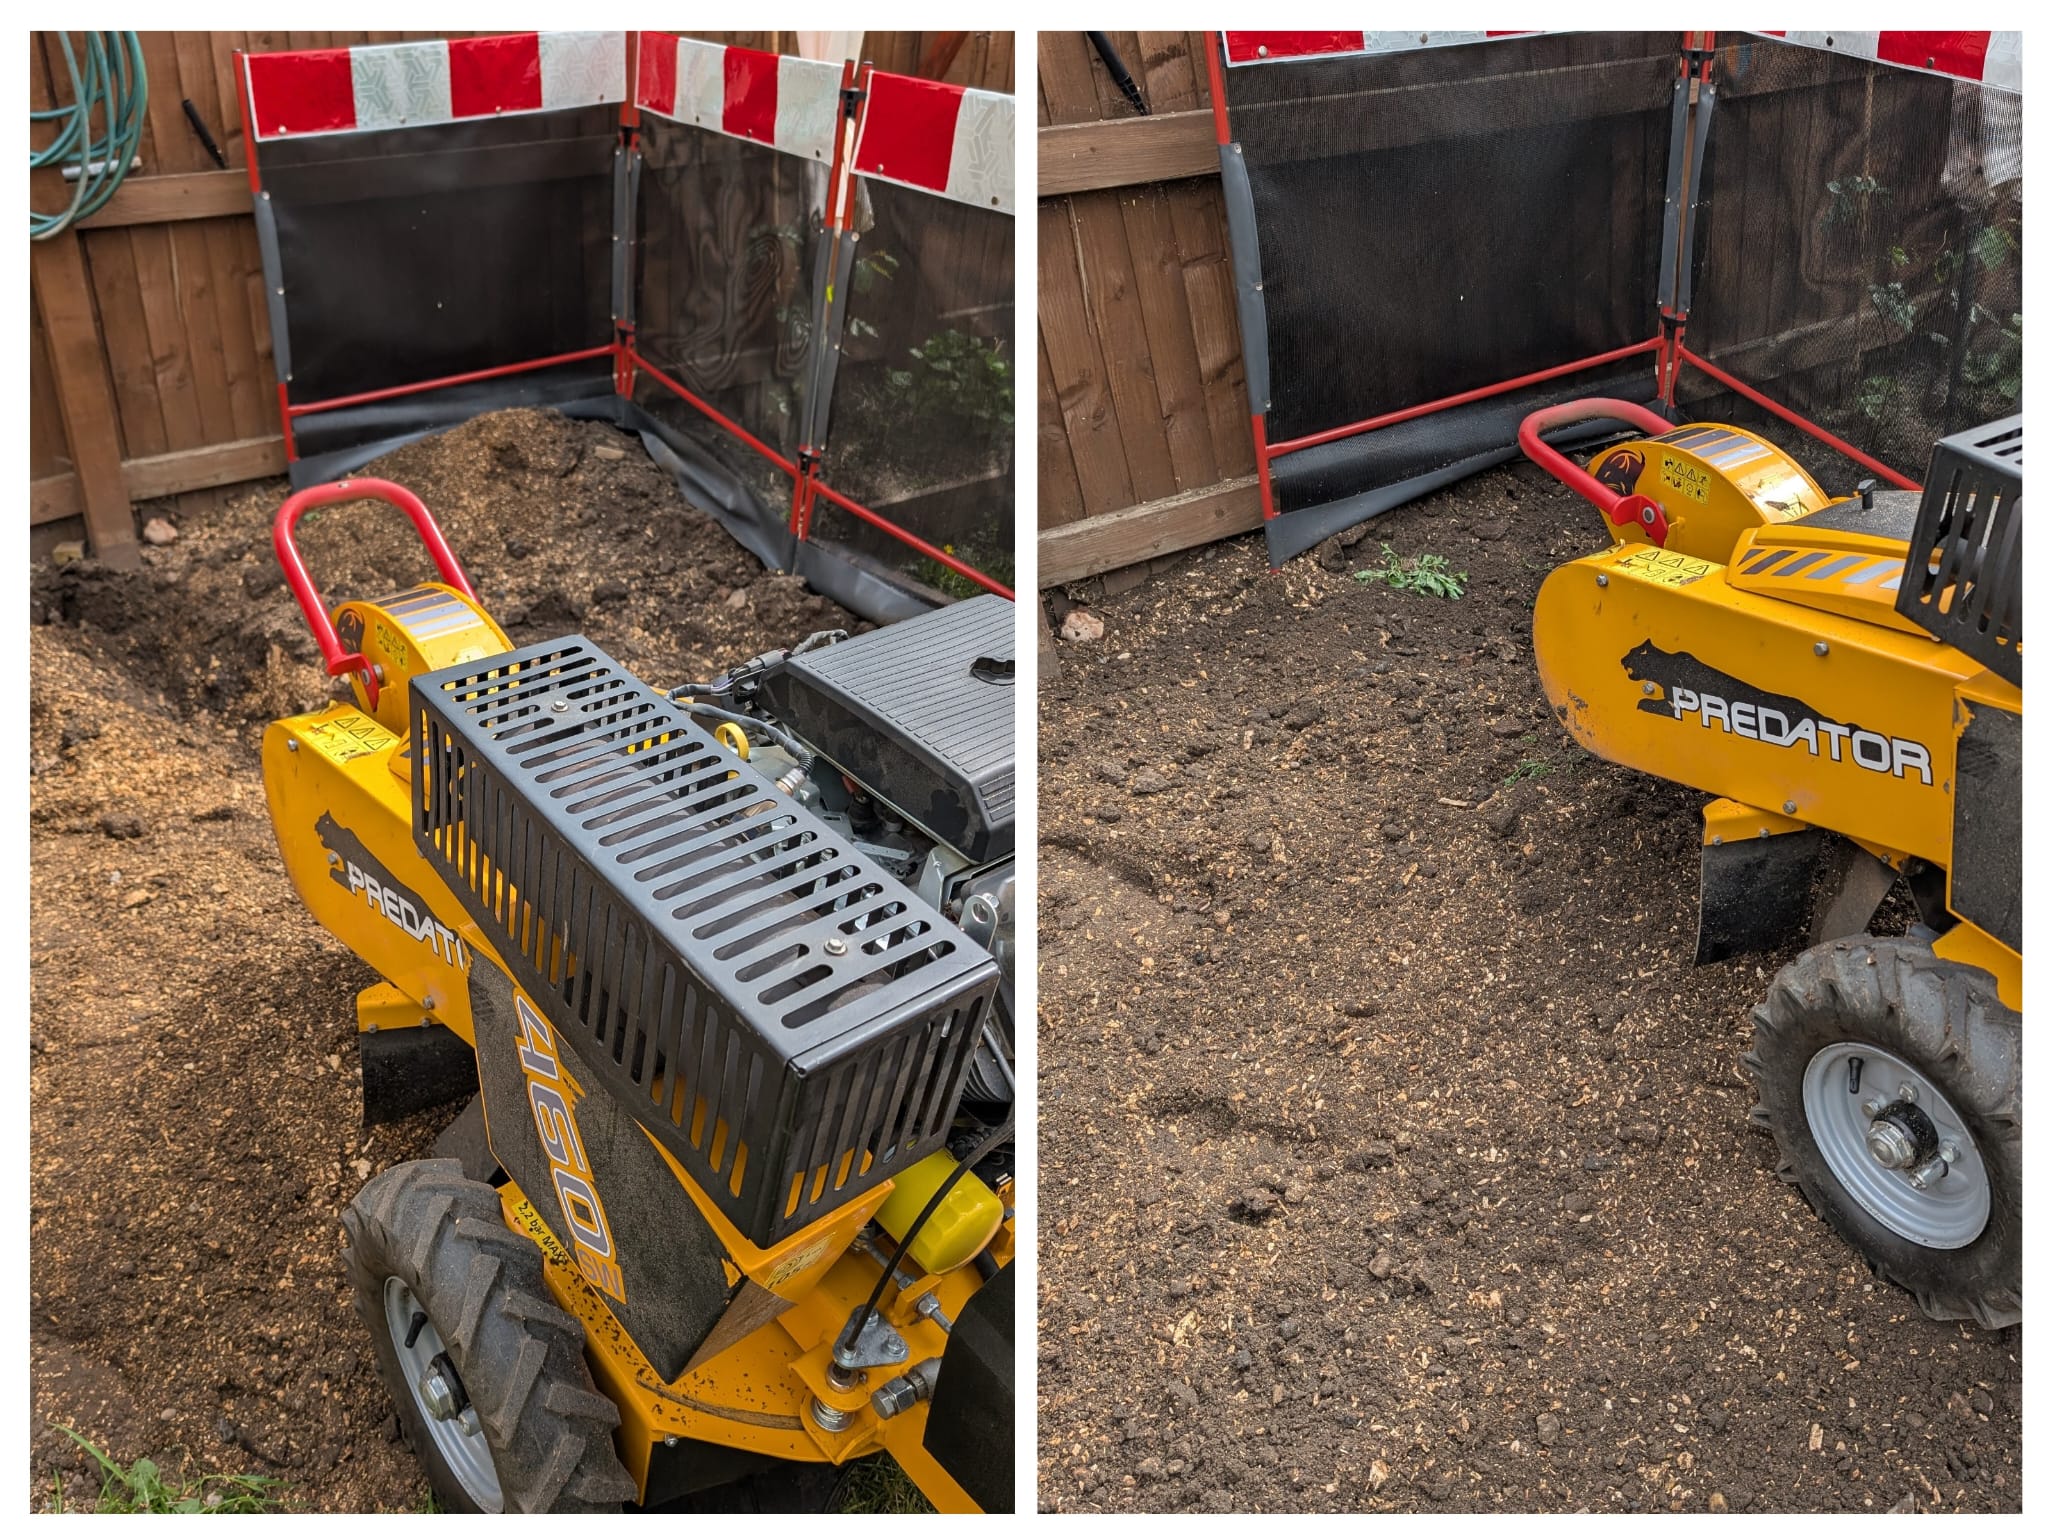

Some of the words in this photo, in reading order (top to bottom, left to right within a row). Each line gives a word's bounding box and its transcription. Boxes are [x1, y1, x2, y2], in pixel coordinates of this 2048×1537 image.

[1671, 687, 1933, 785] PREDATOR
[516, 995, 611, 1257] 460
[518, 1202, 534, 1219] 2,2
[530, 1219, 546, 1235] bar
